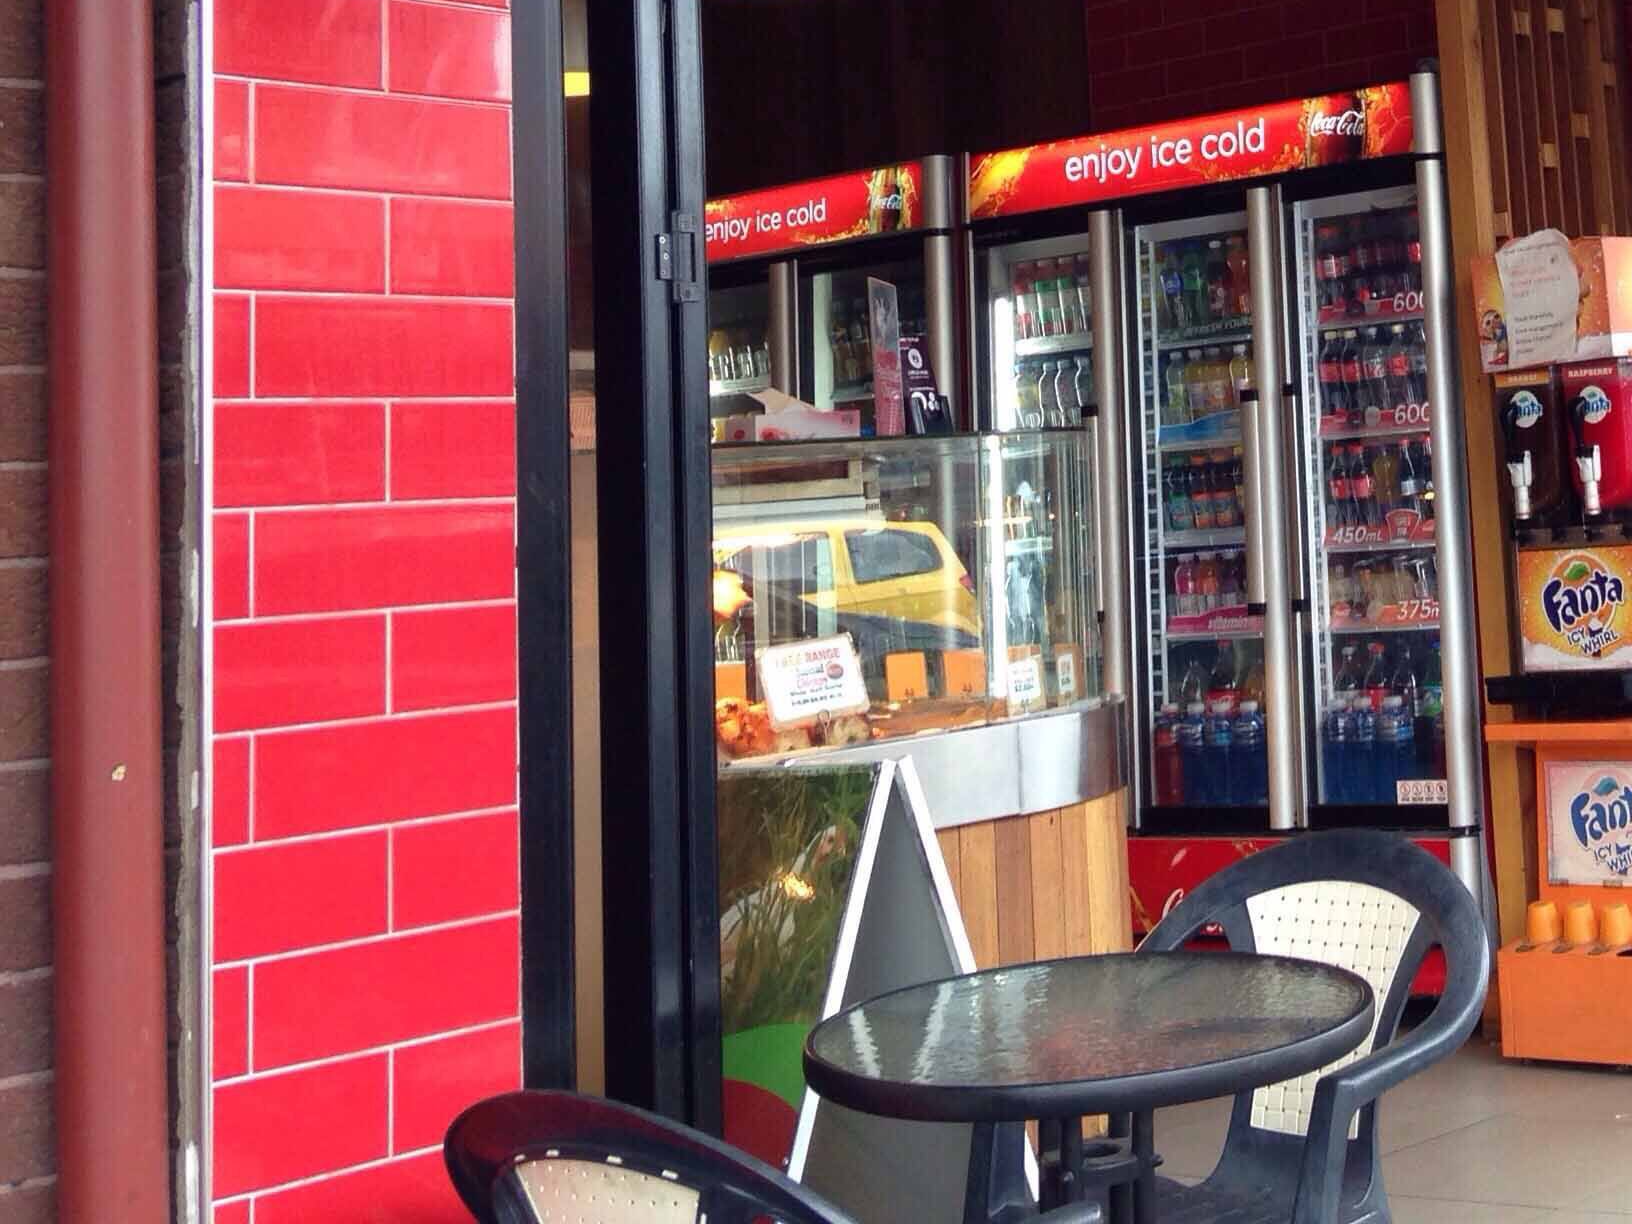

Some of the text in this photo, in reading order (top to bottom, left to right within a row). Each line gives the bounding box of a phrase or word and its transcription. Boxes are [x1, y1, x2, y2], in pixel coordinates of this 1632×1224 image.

[1064, 117, 1266, 184] enjoy ice cold
[705, 196, 827, 244] enjoy ice cold
[1542, 570, 1624, 633] Fanta
[1567, 627, 1586, 646] ICY
[1580, 629, 1619, 654] WHIRL
[1593, 842, 1612, 862] ICY
